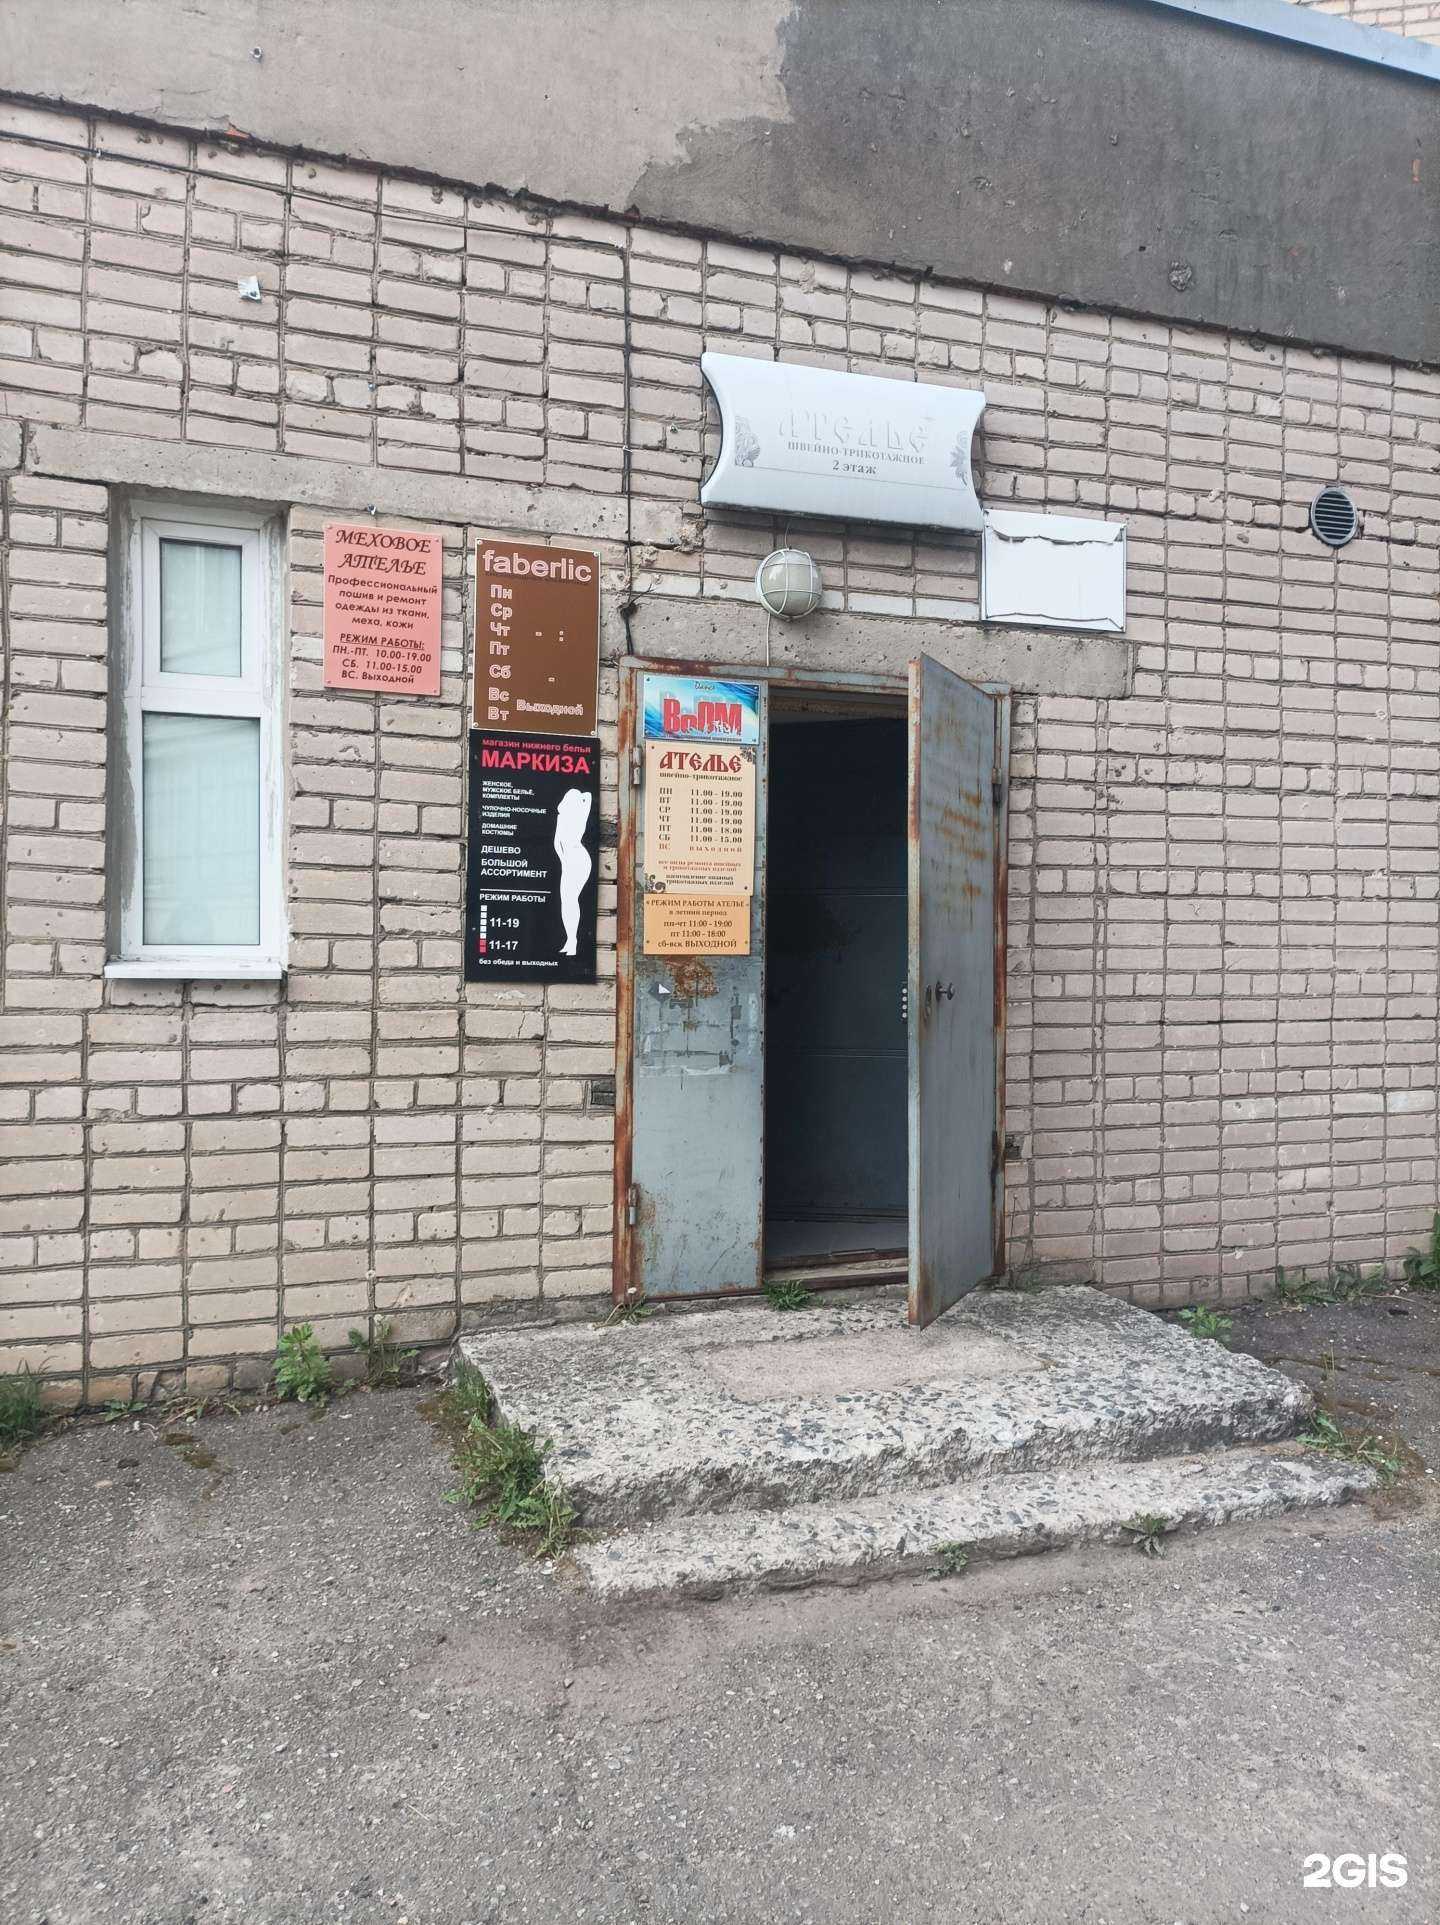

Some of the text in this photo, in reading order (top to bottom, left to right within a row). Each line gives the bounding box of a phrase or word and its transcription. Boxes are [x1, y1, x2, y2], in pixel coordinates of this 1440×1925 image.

[832, 460, 877, 475] 2 этаж
[336, 530, 431, 553] МЕХОВОЕ
[338, 554, 426, 575] АТЕЛЬЕ
[483, 550, 592, 582] faberlic
[328, 575, 437, 594] Профессиональный
[491, 584, 512, 599] Пн
[339, 591, 374, 600] пошив
[386, 595, 426, 606] ремонт
[336, 603, 379, 613] одежды
[491, 603, 512, 620] Ср
[386, 620, 413, 629] кожи
[490, 622, 510, 636] Чт
[340, 633, 424, 649] РЕЖИМ РАБОТЫ:
[490, 641, 510, 655] Пт
[376, 650, 431, 662] 10.00-19.00
[342, 659, 422, 674] СБ. 11.00-15.00
[489, 664, 511, 679] Сб
[342, 670, 414, 684] ВС. Выходной
[488, 688, 509, 701] Вс
[488, 699, 583, 720] Вт Выходной
[482, 739, 590, 753] магазин нижнего белья
[482, 750, 590, 773] МАРКИЗА
[481, 846, 521, 854] ДЕШЕВО
[481, 859, 528, 867] БОЛЬШОЙ
[481, 869, 547, 878] АССОРТИМЕНТ
[489, 918, 519, 928] 11-19
[489, 941, 518, 950] 11-17
[685, 939, 736, 948] ВЫХОДНОЙ
